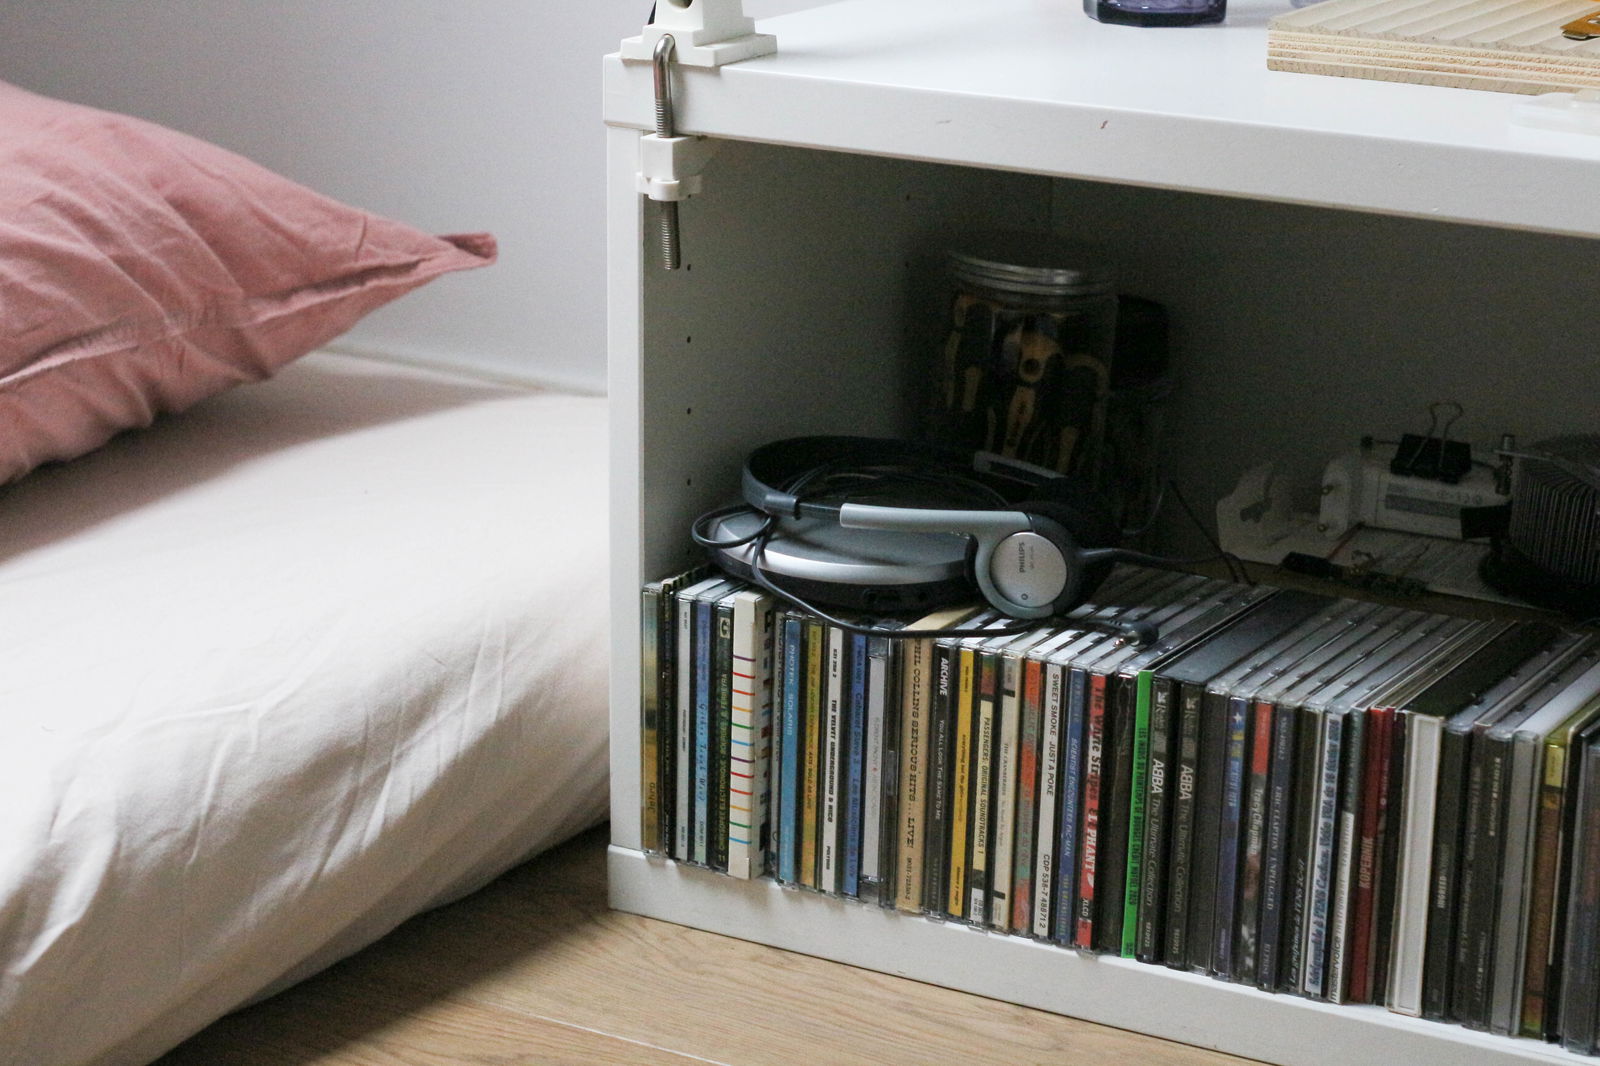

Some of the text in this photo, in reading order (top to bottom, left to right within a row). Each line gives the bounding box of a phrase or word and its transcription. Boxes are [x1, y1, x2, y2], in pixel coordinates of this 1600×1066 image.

[912, 668, 920, 718] COLLINS
[939, 658, 949, 696] ARCHIVE
[1052, 673, 1060, 702] SWEET
[982, 717, 990, 764] PASSENGERS:
[1050, 704, 1058, 736] SMOKE
[1088, 687, 1104, 800] The White Stripes
[910, 720, 919, 772] SERIOUS
[980, 765, 988, 796] ORIGINAL
[1066, 775, 1075, 822] ENCOUNTERS
[978, 799, 986, 848] SOUNDTRACKS
[1064, 824, 1072, 857] PAC-MAN
[1146, 759, 1165, 906] ABBA The Ultimate Collection
[1174, 765, 1193, 913] ABBA The Ultimate Collection
[1250, 788, 1263, 855] Tracy Chapman
[1272, 809, 1280, 850] CLAPTON
[1266, 857, 1277, 910] UNPLUGGED
[1358, 836, 1373, 888] KOPERNIK
